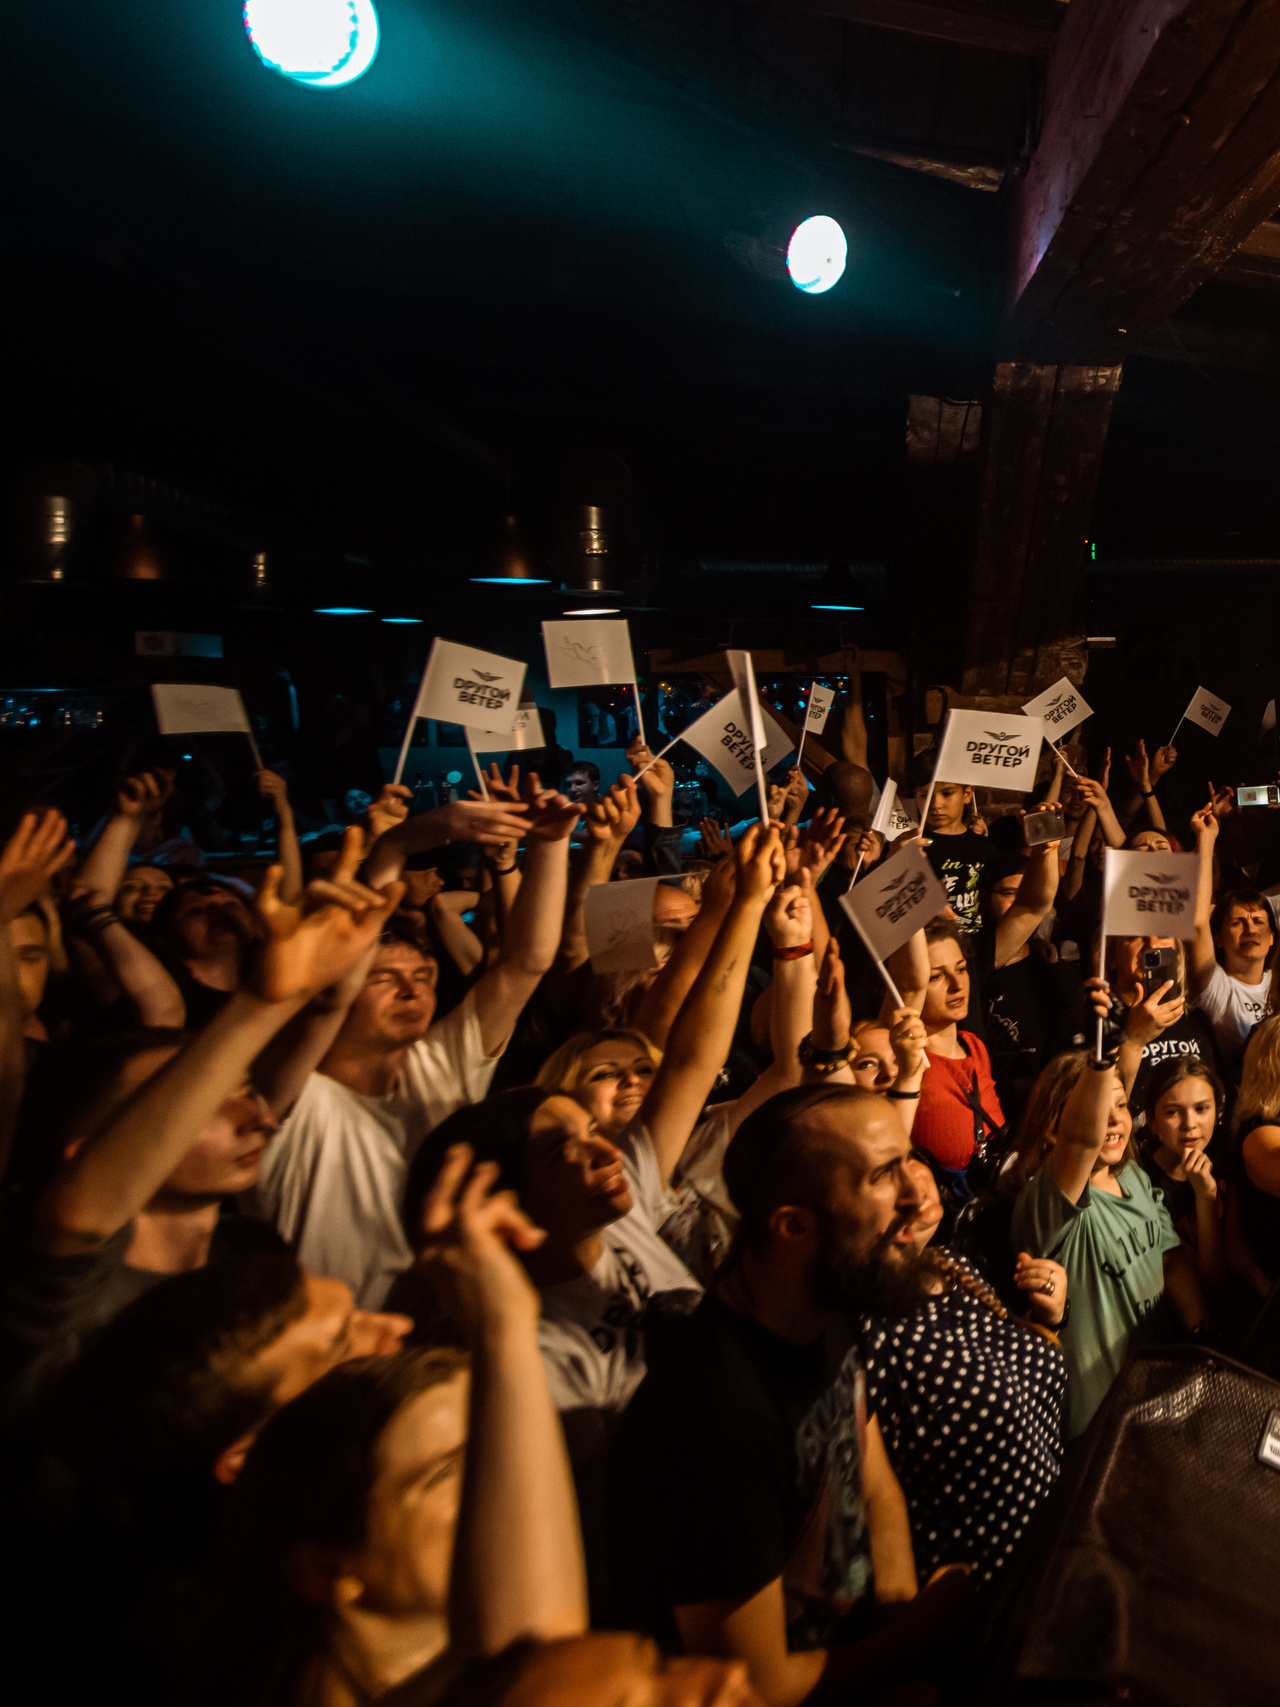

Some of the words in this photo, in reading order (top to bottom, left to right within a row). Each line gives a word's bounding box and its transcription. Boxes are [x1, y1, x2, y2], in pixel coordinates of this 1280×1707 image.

[458, 691, 504, 710] ВЕТЕР
[1051, 703, 1077, 724] ВЕТЕР
[720, 734, 756, 771] ВЕТЕР
[971, 753, 1023, 768] ВЕТЕР
[1136, 899, 1186, 915] ВЕТЕР
